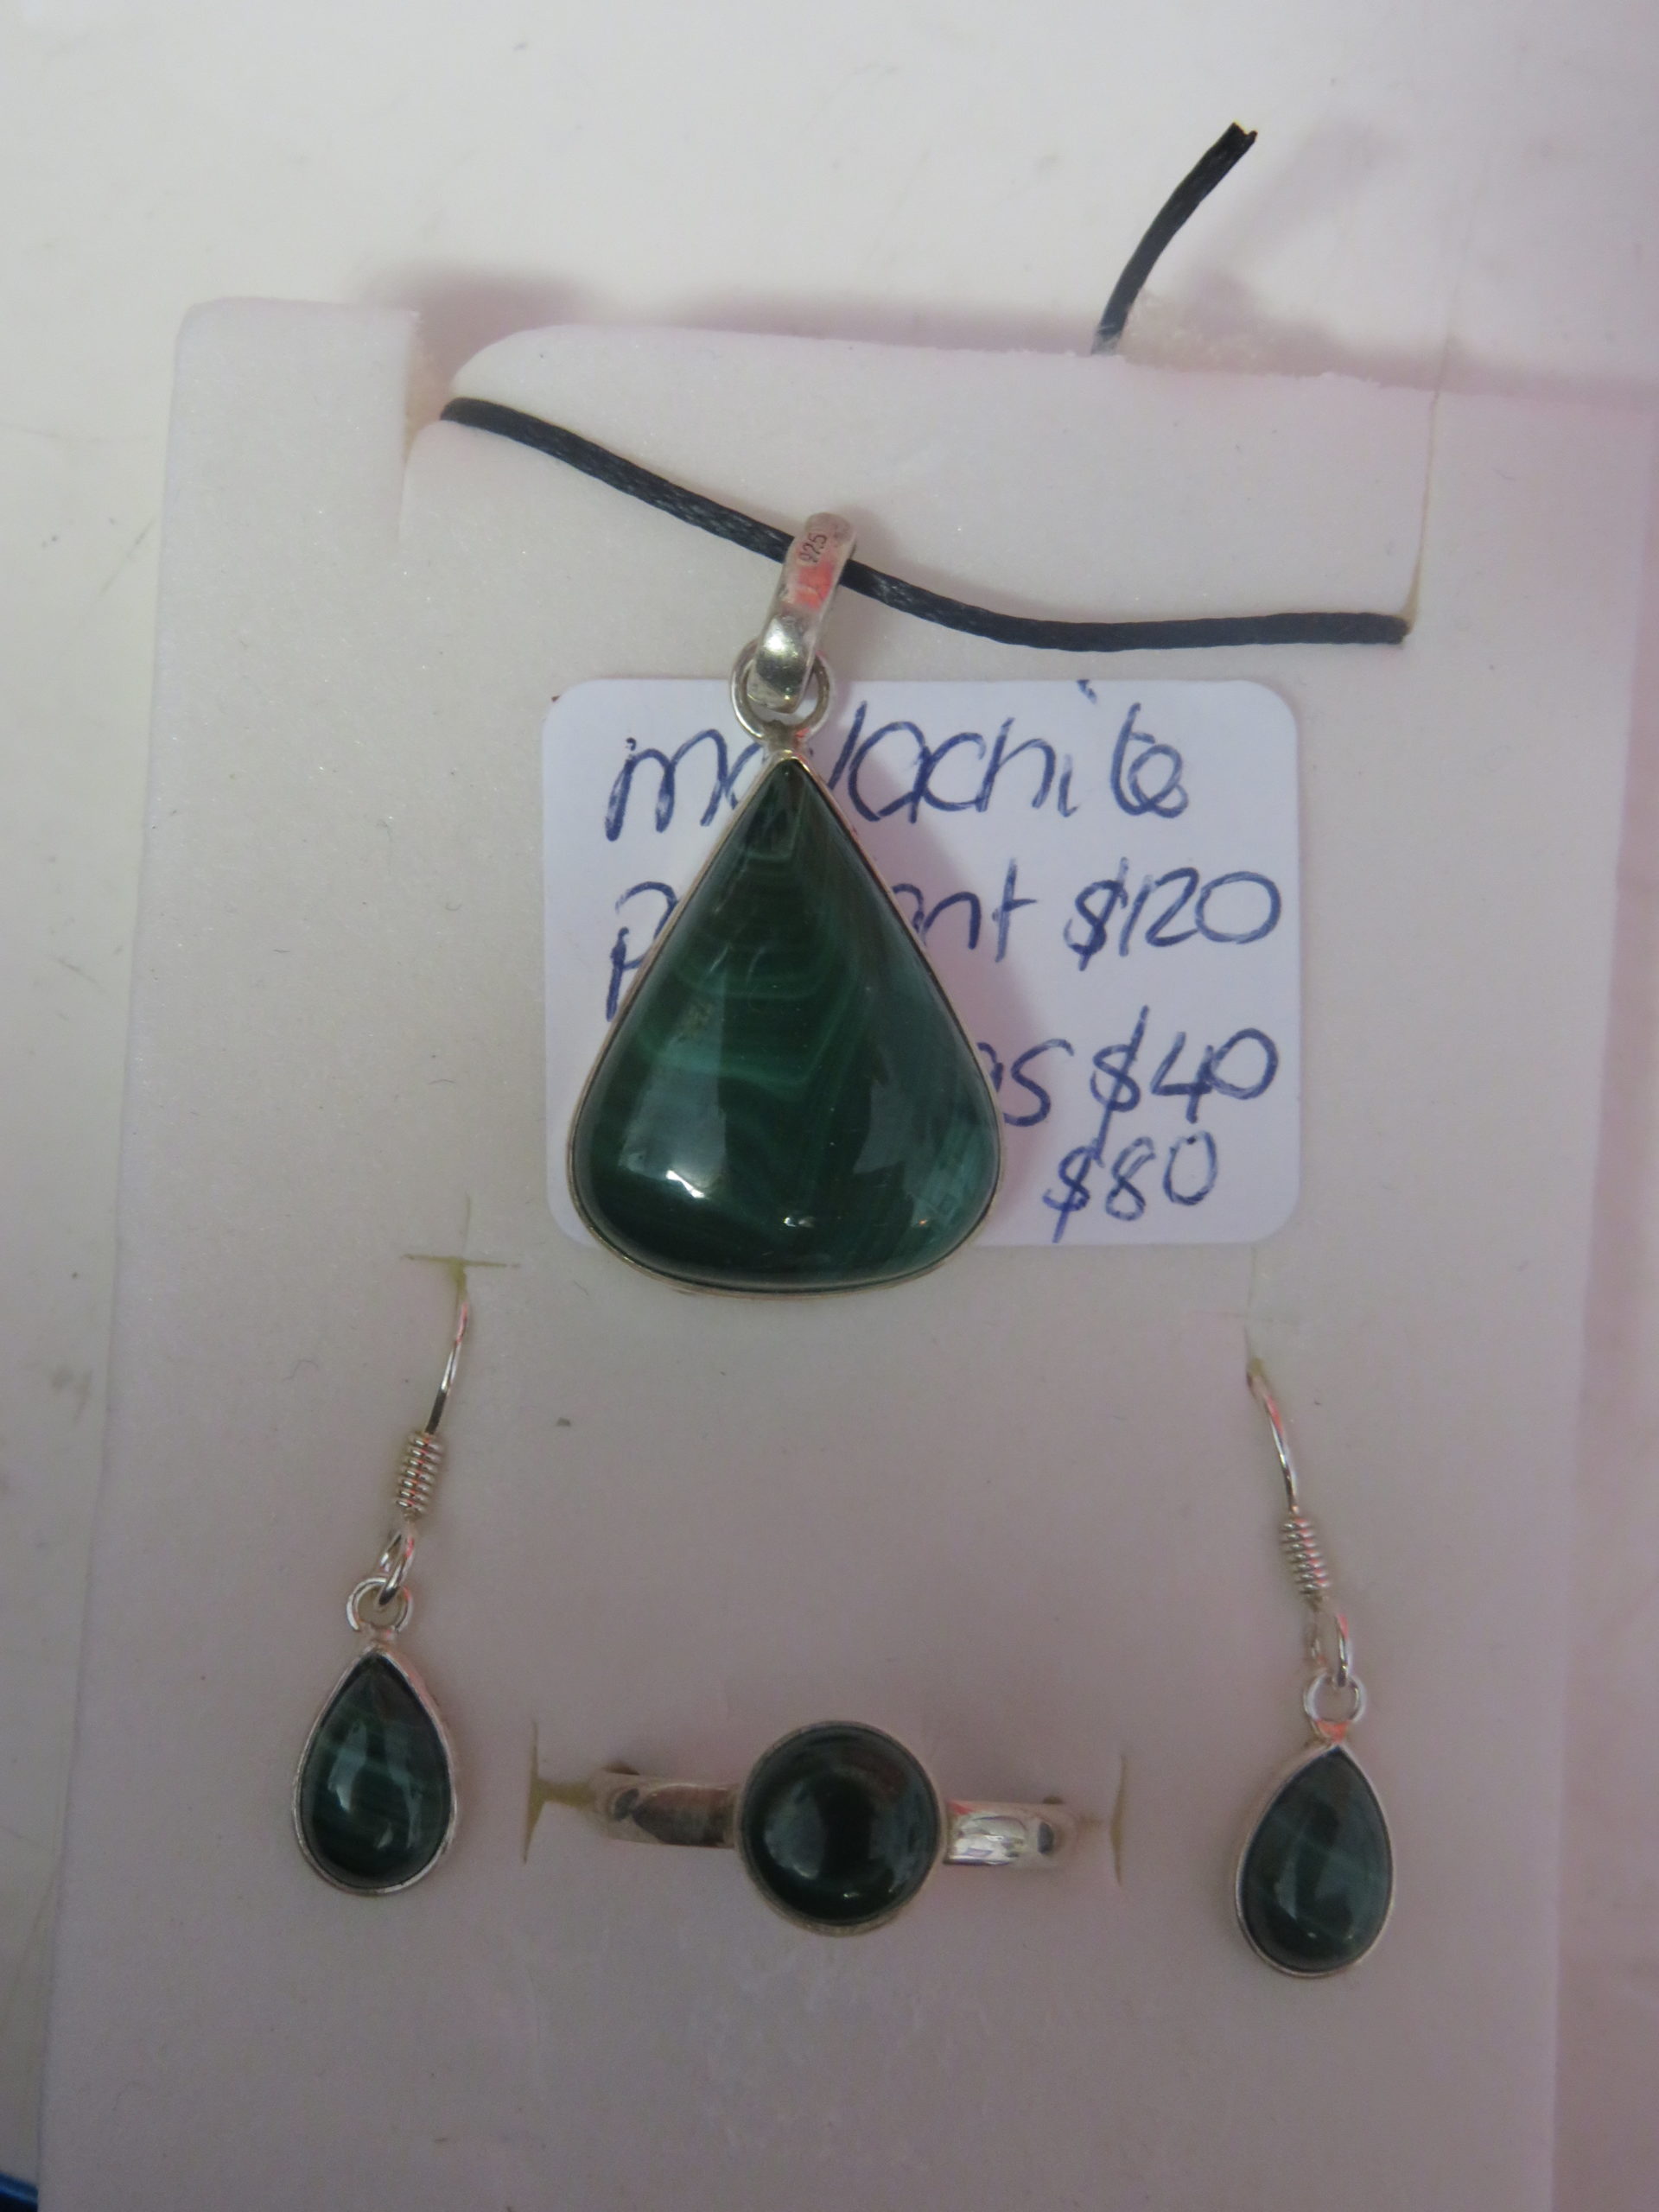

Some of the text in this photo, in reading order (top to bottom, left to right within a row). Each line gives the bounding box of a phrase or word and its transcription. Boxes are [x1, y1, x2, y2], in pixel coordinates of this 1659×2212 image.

[798, 531, 828, 563] 925
[1064, 857, 1282, 971] $120
[1090, 1005, 1280, 1167] $40
[1042, 1130, 1218, 1244] $80
